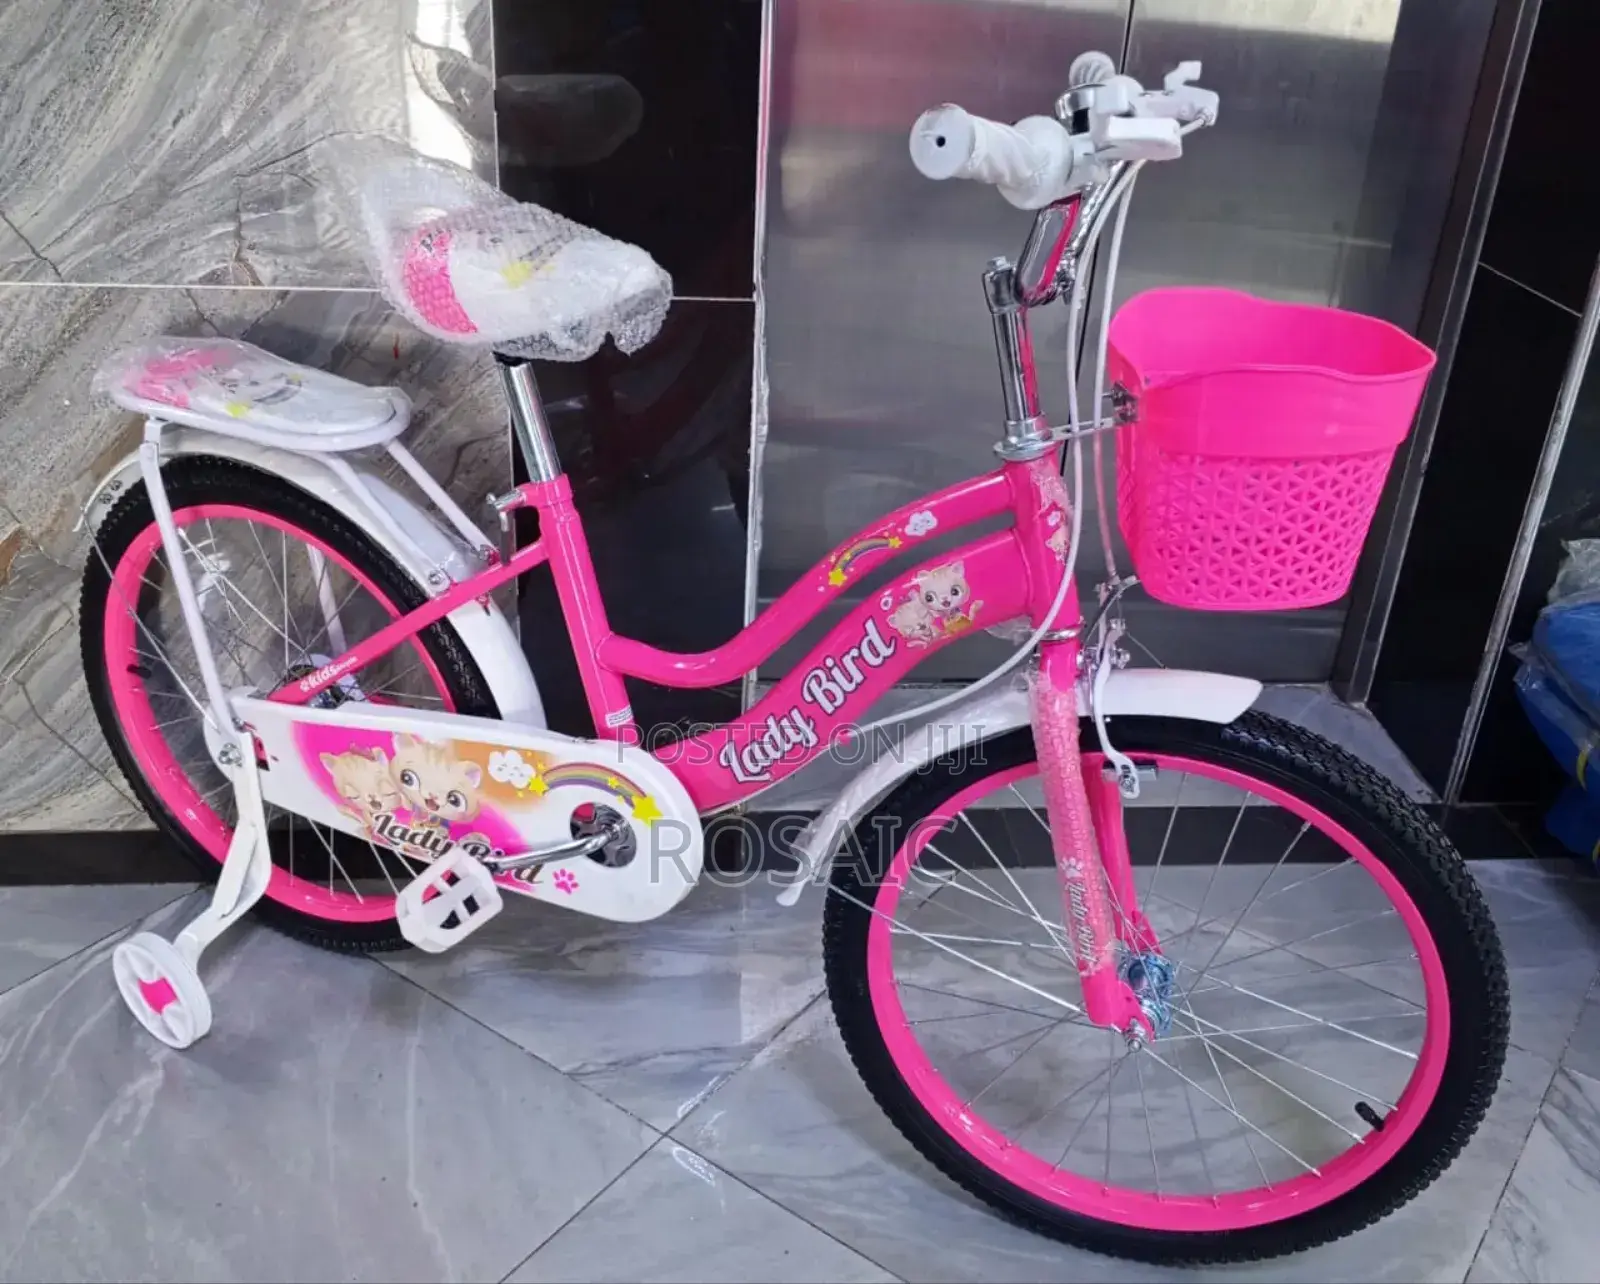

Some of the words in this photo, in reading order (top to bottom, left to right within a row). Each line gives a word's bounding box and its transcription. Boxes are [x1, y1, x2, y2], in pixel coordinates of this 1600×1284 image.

[308, 663, 338, 689] kids
[719, 706, 819, 783] Lady
[802, 617, 896, 715] Bird
[374, 814, 454, 859] Lady
[462, 842, 545, 884] Bd
